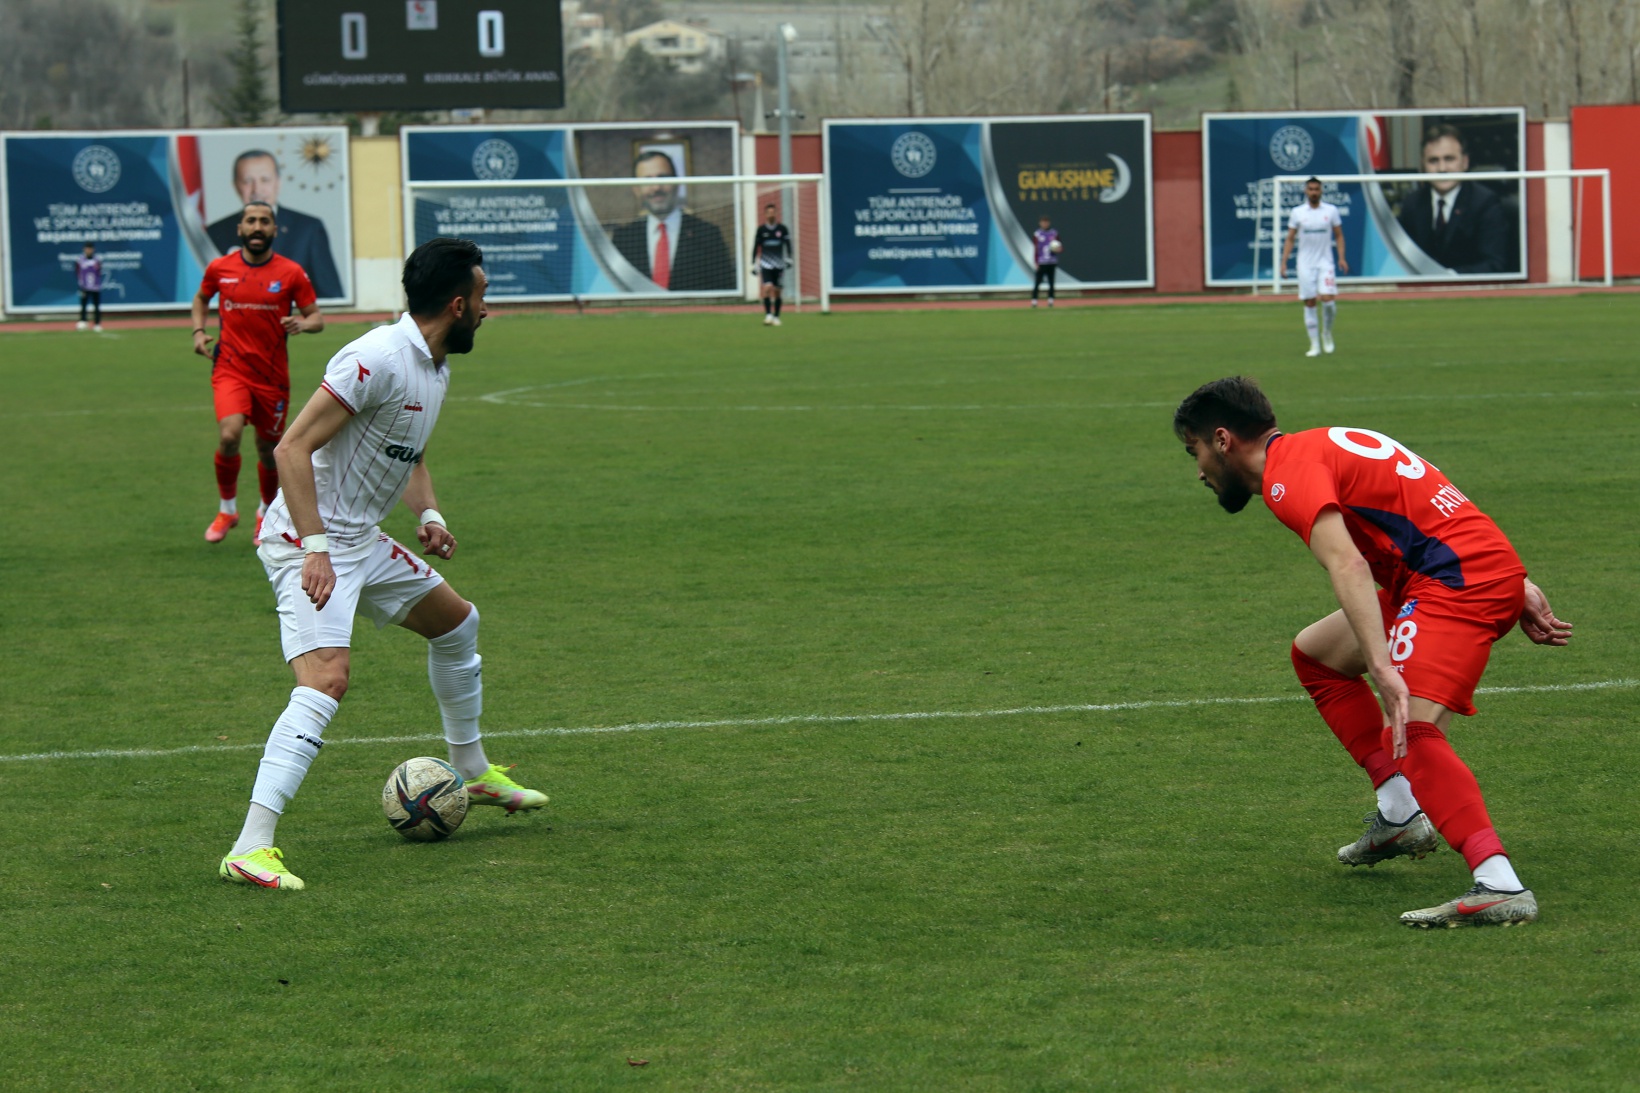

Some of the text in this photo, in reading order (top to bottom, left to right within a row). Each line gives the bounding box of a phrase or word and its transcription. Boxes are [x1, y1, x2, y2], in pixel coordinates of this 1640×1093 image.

[341, 12, 367, 59] 0
[478, 10, 504, 57] 0
[1018, 169, 1115, 191] GÜMÜŞHANE
[449, 195, 545, 208] TÜM ANTRENÖR
[868, 194, 962, 208] TÜM ANTRENÖR
[1233, 194, 1248, 207] VE
[48, 201, 149, 216] TÜM ANTRENÖR
[434, 209, 450, 222] VE
[854, 207, 976, 222] VE SPORCULARIMIZA
[34, 215, 163, 230] VE SPORCULARIMIZA
[854, 223, 918, 237] BAŞARILAR
[37, 231, 98, 244] BAŞARILAR
[868, 247, 934, 260] GÜMÜŞHANE
[273, 413, 284, 431] 7
